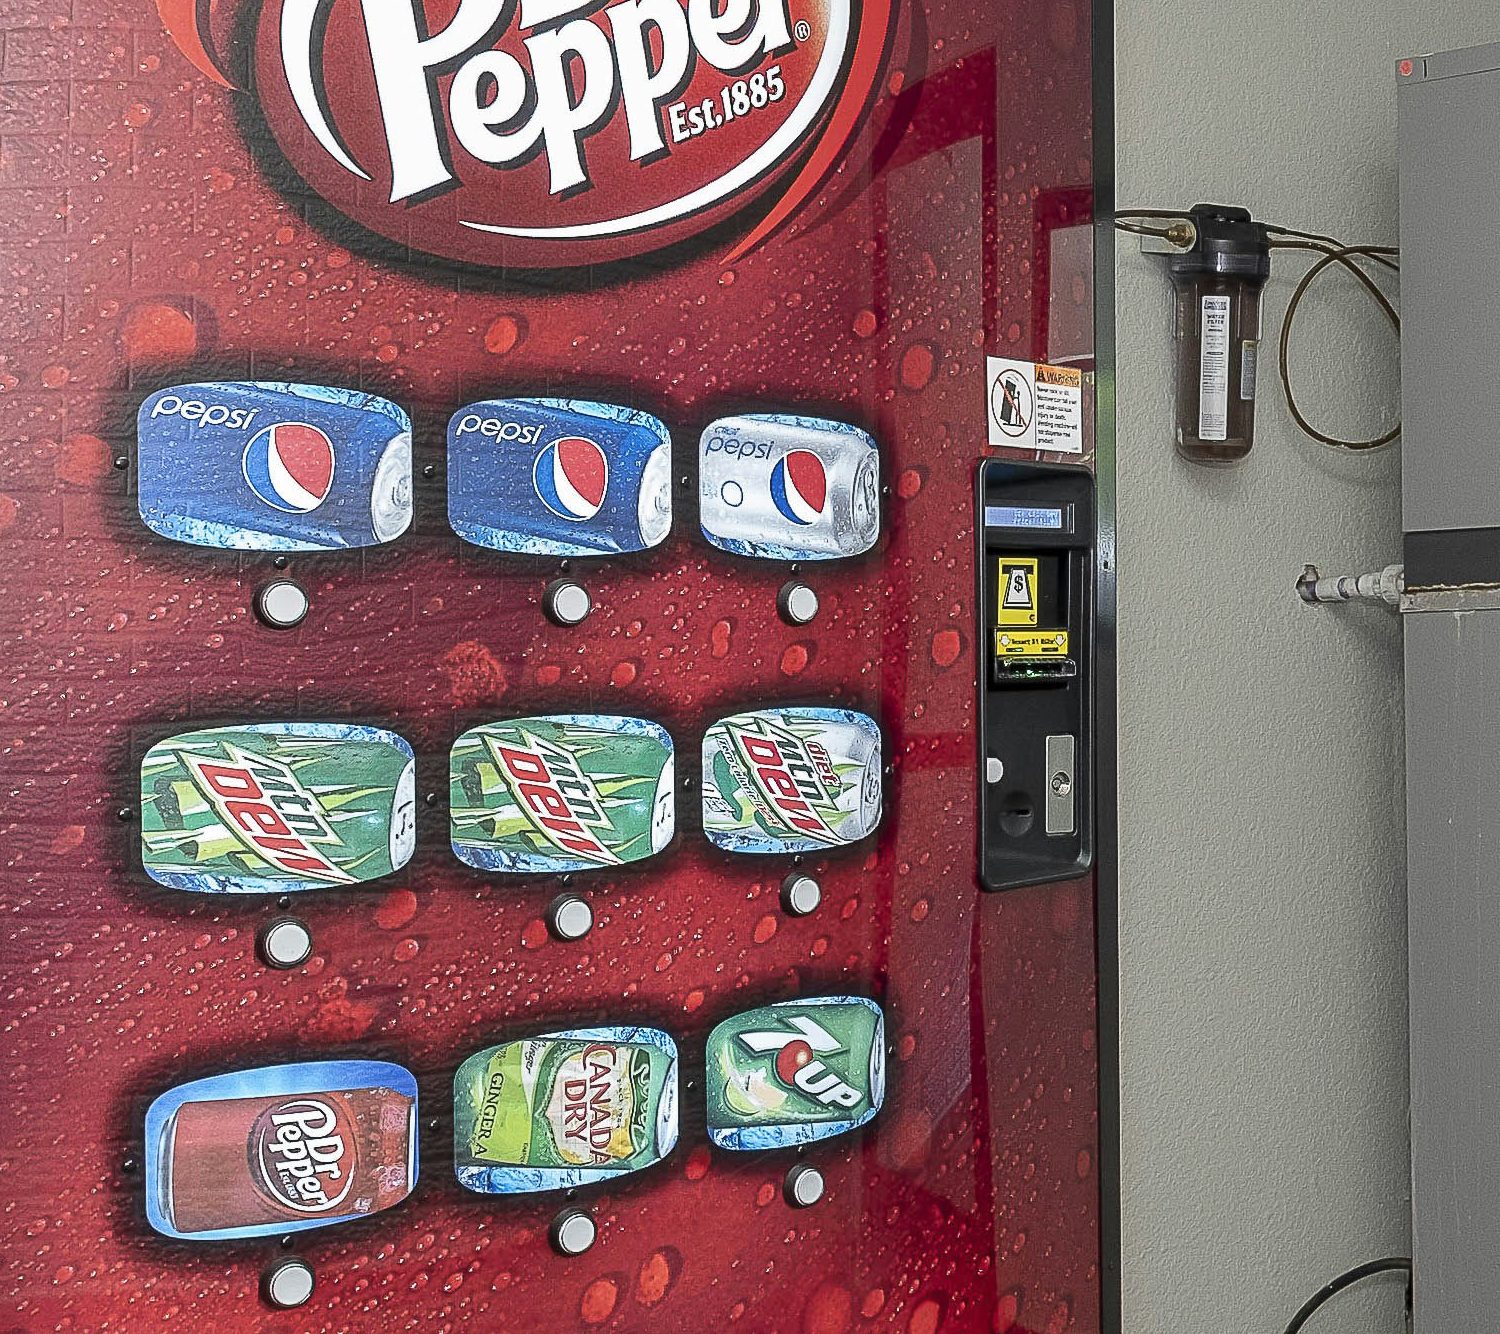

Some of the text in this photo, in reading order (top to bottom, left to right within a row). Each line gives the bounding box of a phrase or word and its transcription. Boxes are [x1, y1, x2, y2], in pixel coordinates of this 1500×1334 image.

[150, 395, 259, 430] pepsi
[455, 415, 545, 445] pepsi
[705, 436, 774, 461] pepsi
[478, 1072, 504, 1140] GINGER
[564, 1079, 588, 1142] DRY
[582, 1044, 617, 1165] CANADA
[268, 1099, 337, 1205] Pepper
[305, 1134, 345, 1181] Dr
